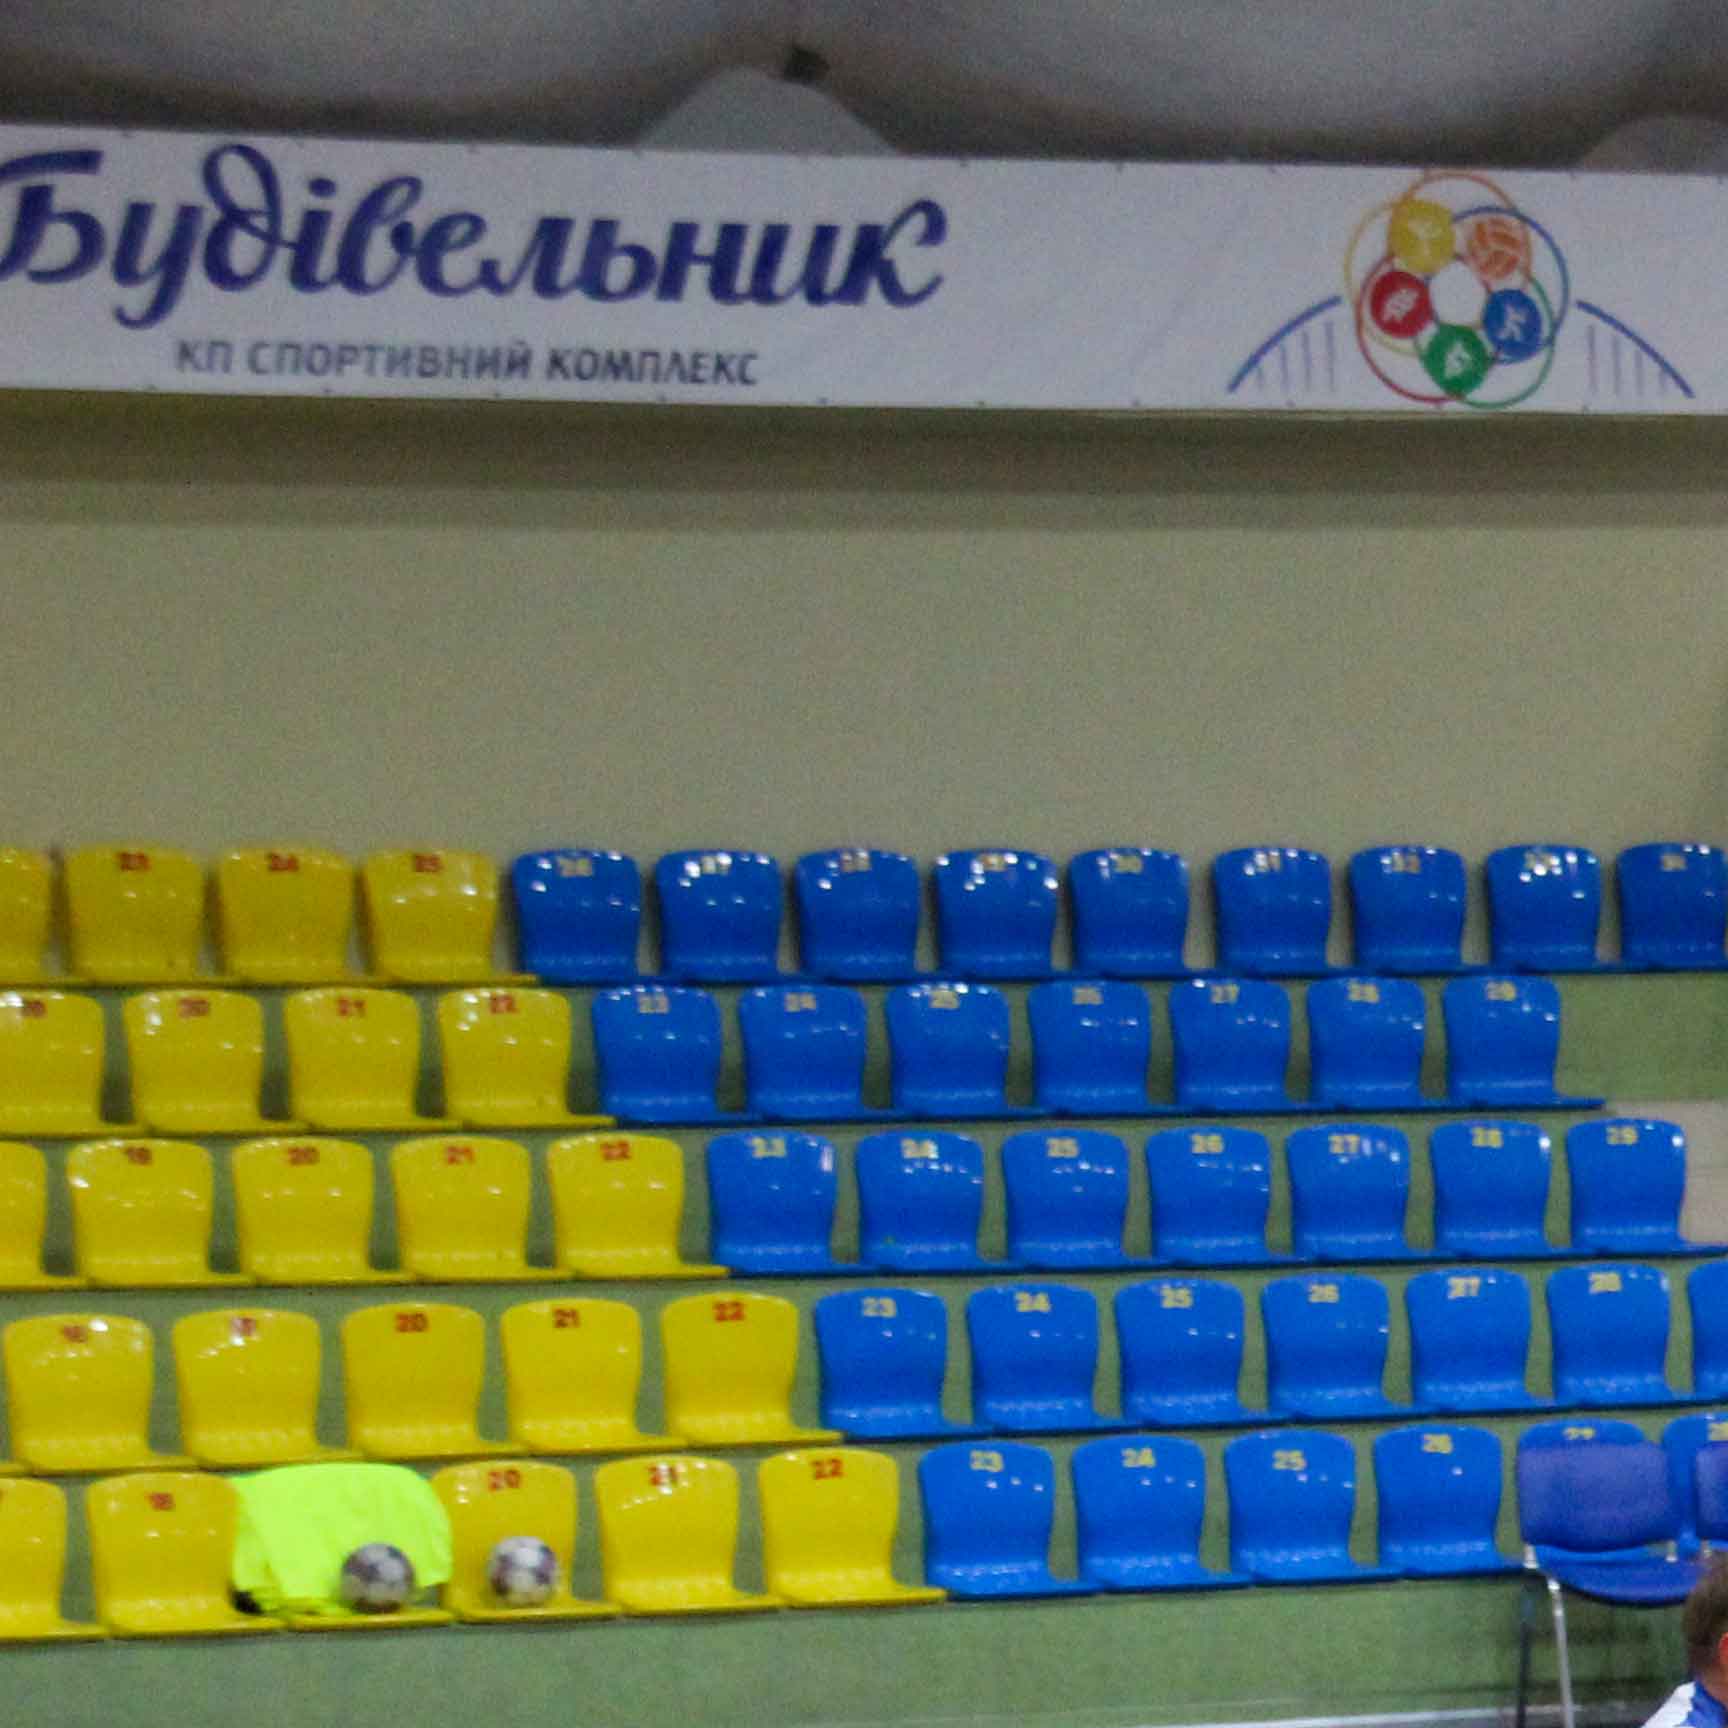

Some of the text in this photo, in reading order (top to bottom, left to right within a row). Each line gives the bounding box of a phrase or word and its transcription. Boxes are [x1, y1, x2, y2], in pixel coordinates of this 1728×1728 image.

[0, 144, 948, 329] Будівельник
[174, 340, 760, 387] КП СПОРТИВНИЙ КОМПЛЕКС
[1329, 1134, 1361, 1154] 27
[1160, 1286, 1193, 1308] 25
[1308, 1283, 1339, 1302] 26
[1448, 1276, 1481, 1298] 27
[712, 1301, 746, 1324] 22
[862, 1297, 897, 1318] 23
[1015, 1291, 1051, 1312] 24
[552, 1307, 580, 1329] 21
[970, 1450, 1004, 1473] 23
[1123, 1447, 1156, 1468] 24
[1272, 1449, 1307, 1472] 25
[812, 1457, 845, 1481] 22
